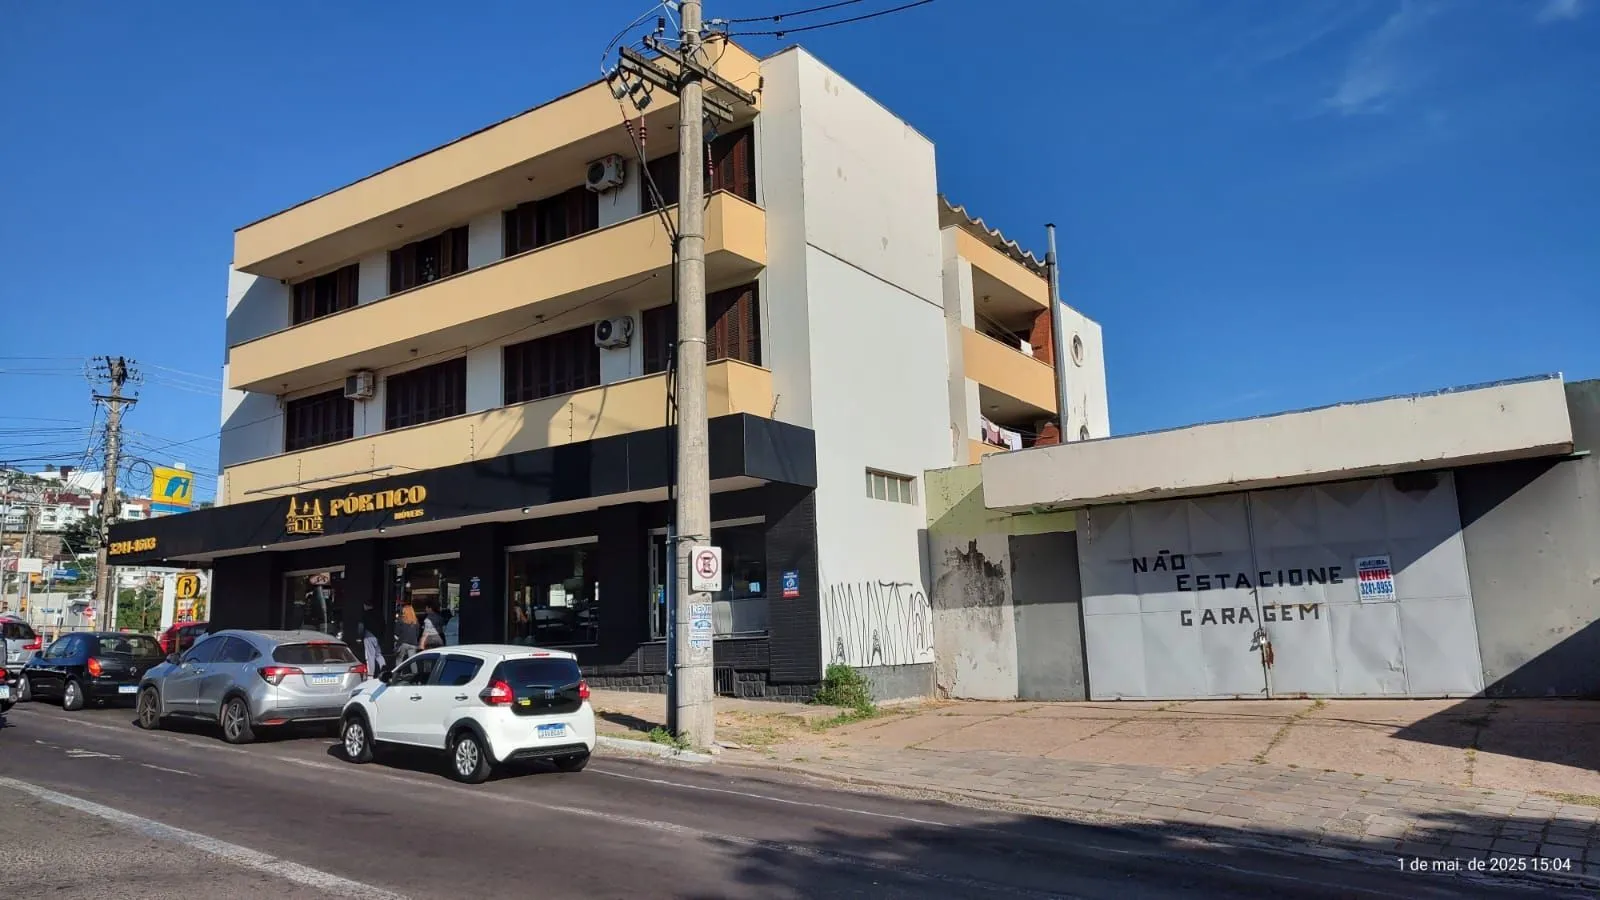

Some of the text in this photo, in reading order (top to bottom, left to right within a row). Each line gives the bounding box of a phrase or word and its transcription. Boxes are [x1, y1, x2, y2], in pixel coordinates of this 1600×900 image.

[330, 485, 427, 517] PÓRTICO
[393, 508, 425, 520] MÓVEIS
[1132, 550, 1186, 573] NÃO
[1176, 566, 1344, 592] ESTACIONE
[1359, 568, 1392, 581] VENDE
[1180, 602, 1320, 626] GARAGEM
